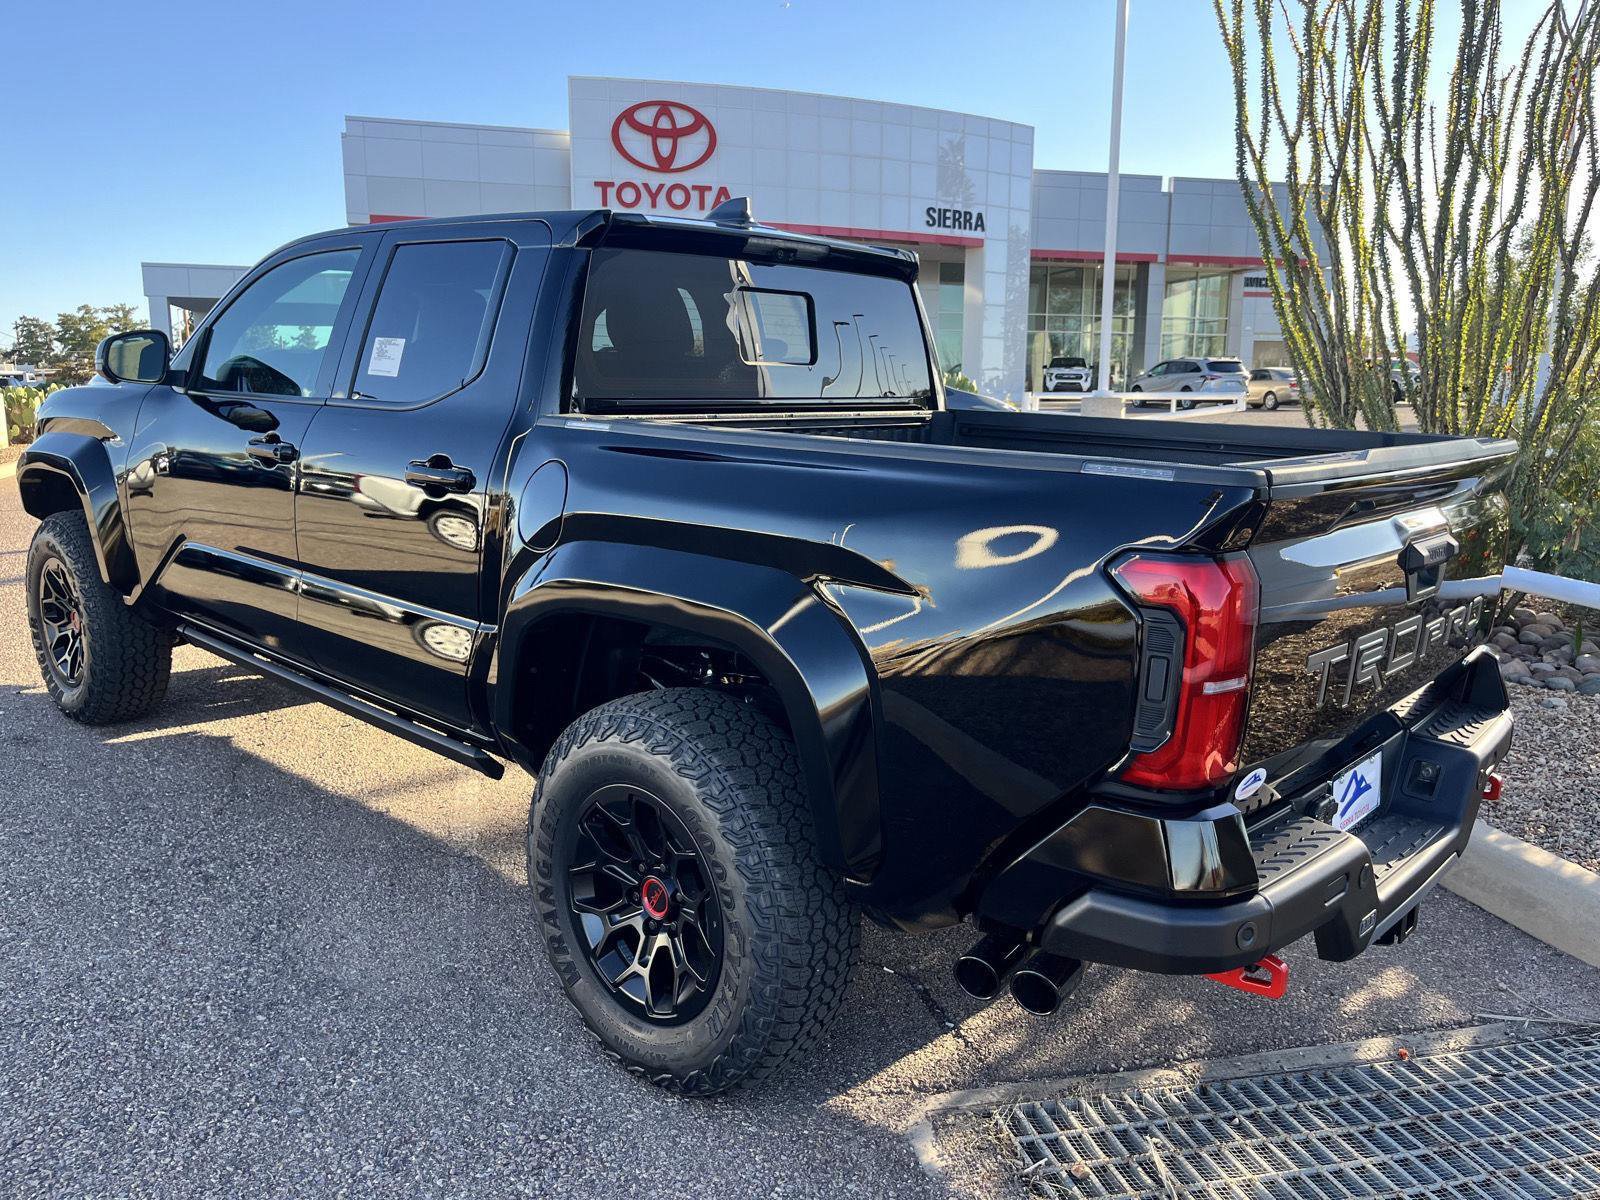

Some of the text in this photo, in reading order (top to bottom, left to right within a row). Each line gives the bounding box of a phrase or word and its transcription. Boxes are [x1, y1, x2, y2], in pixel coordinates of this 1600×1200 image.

[594, 181, 731, 211] TOYOTA
[926, 206, 985, 232] SIERRA
[1307, 614, 1422, 709] TRD
[537, 798, 582, 988] WRANGLER
